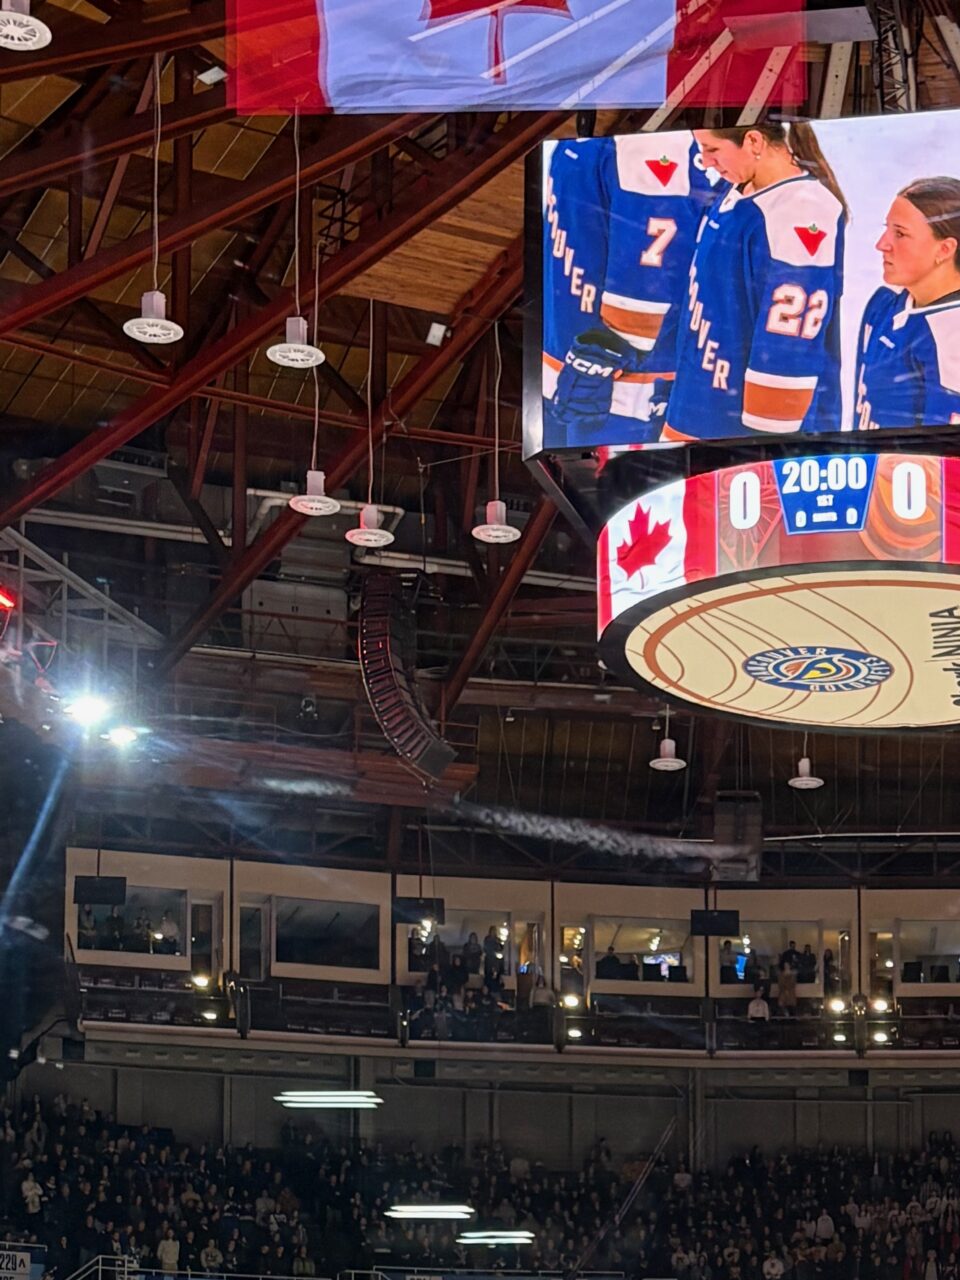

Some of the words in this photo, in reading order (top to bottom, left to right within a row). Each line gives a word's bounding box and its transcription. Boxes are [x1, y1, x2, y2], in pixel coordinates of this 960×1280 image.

[639, 217, 678, 268] 7
[766, 284, 829, 340] 22
[565, 351, 614, 378] CCM
[782, 457, 867, 494] 20:00
[892, 462, 927, 520] 0
[730, 471, 761, 529] 0
[746, 647, 827, 682] VANCOUVER
[810, 656, 892, 692] GOLDENEYES
